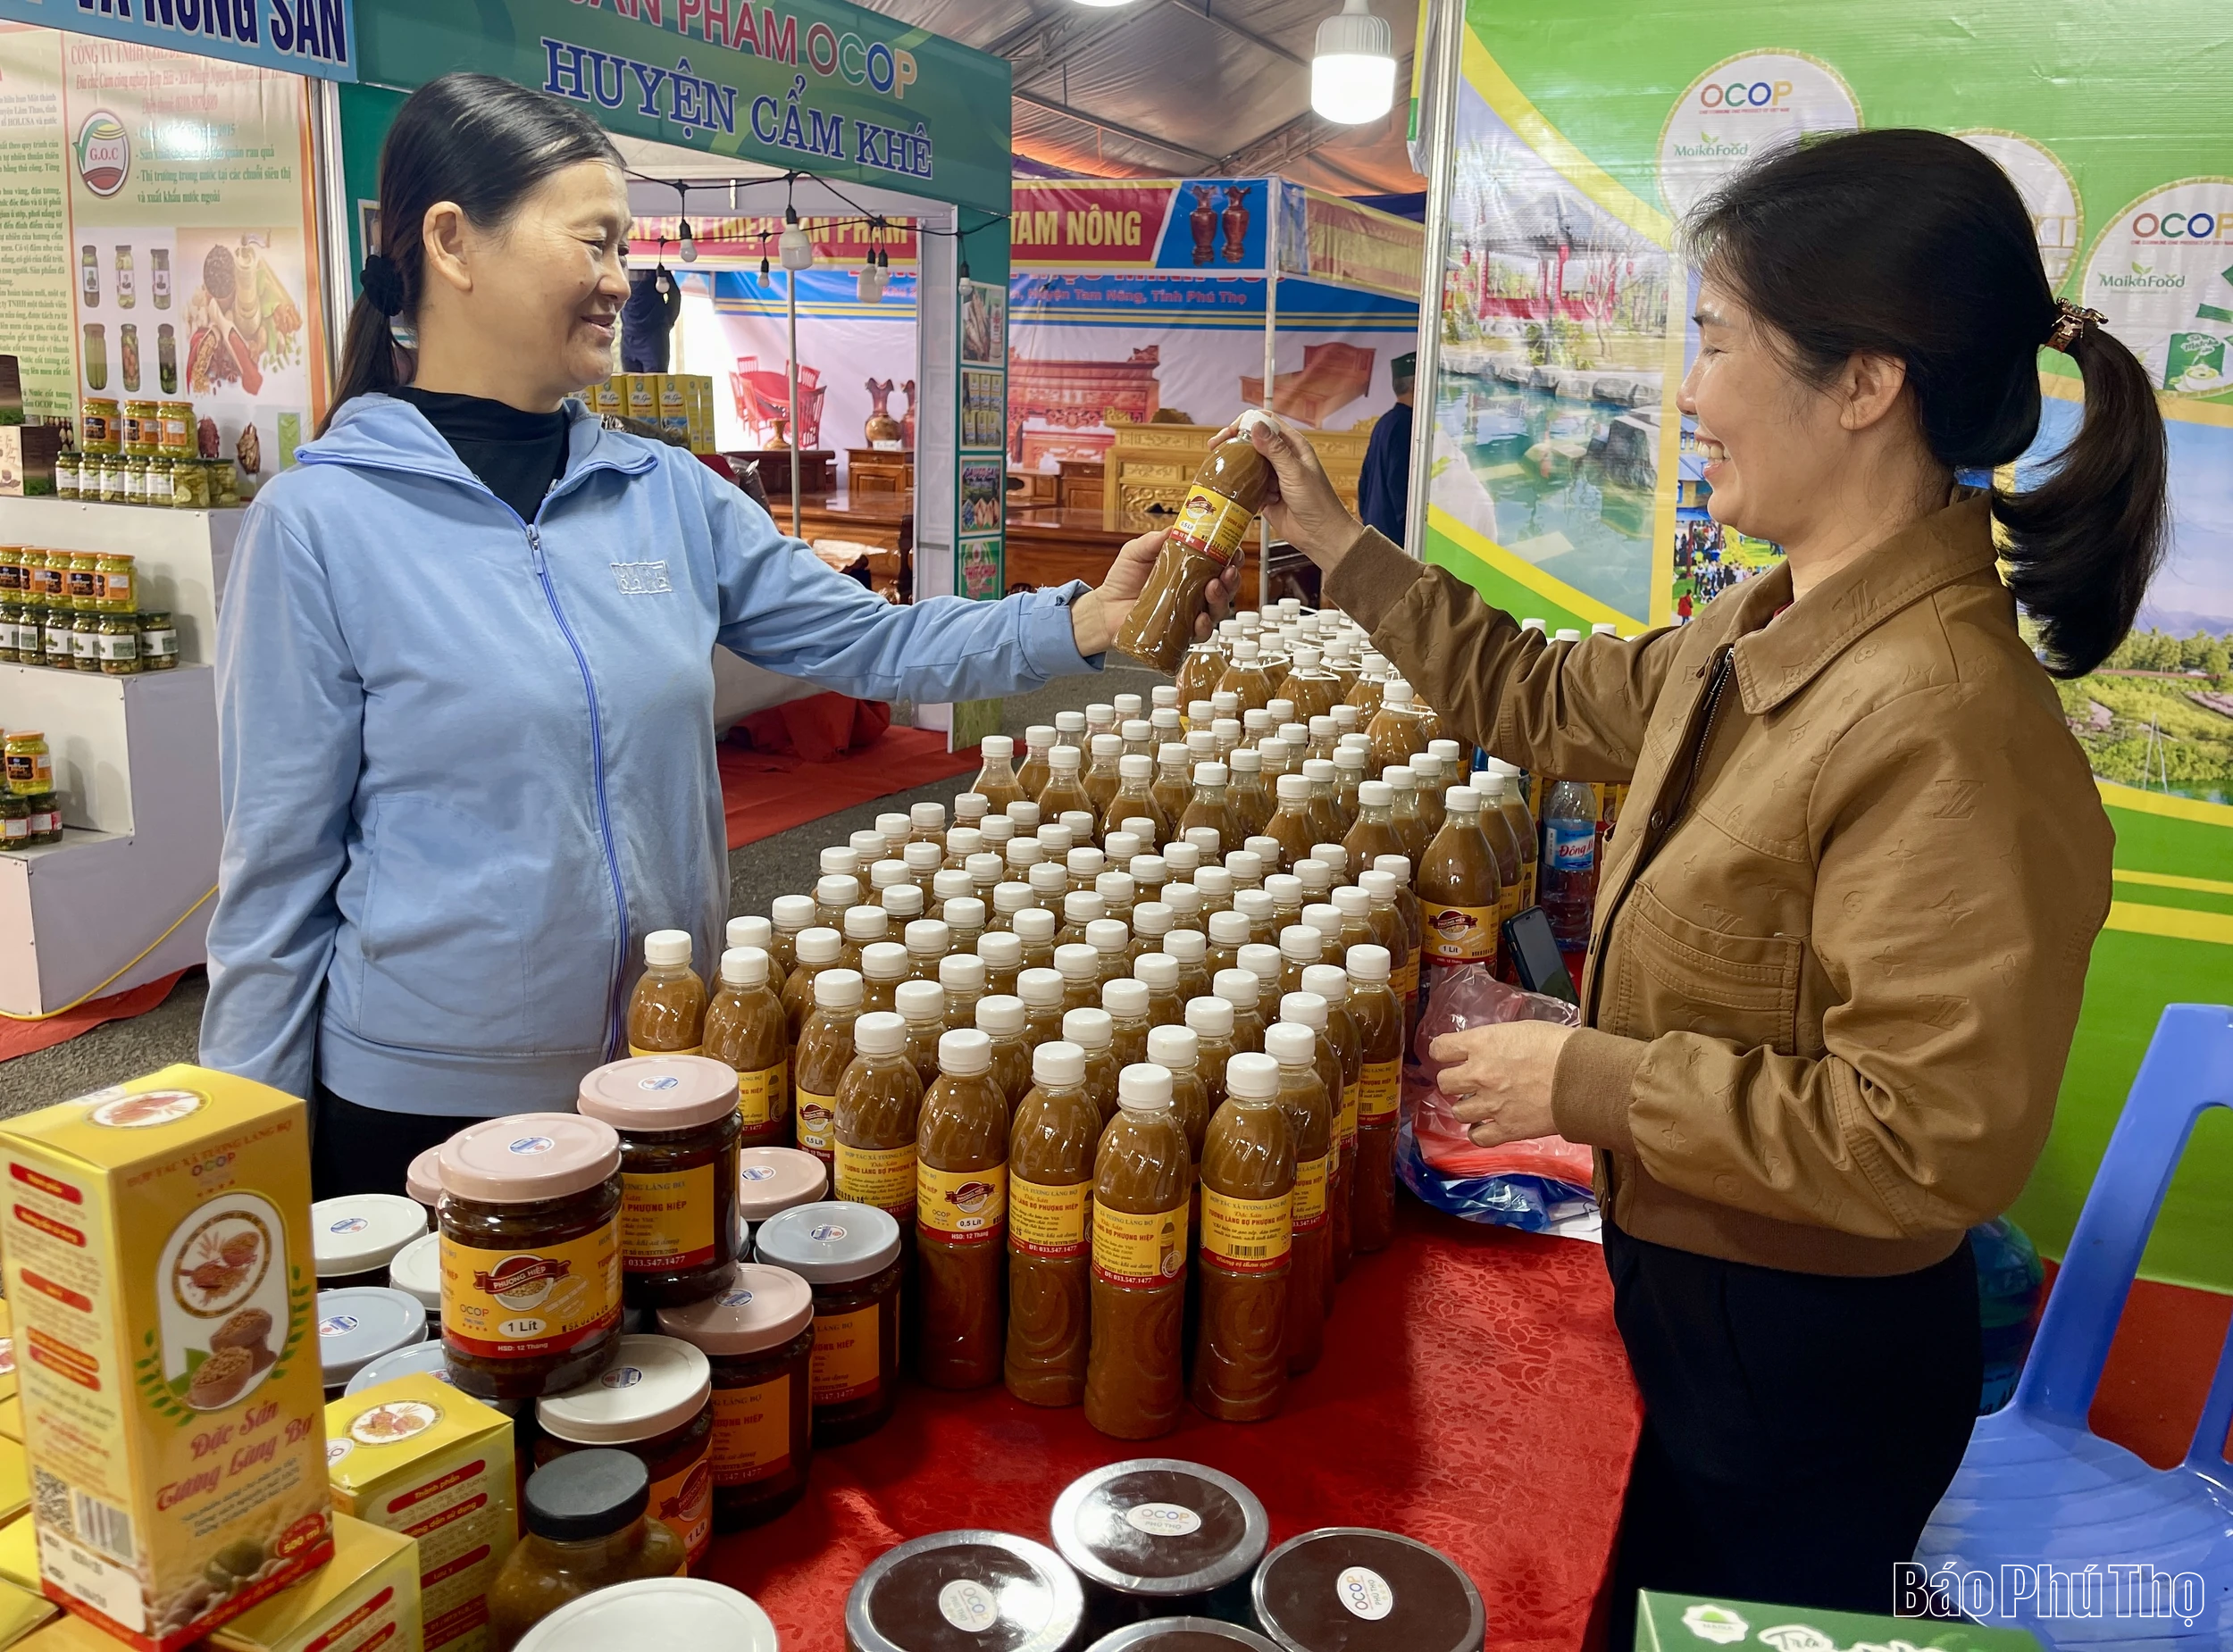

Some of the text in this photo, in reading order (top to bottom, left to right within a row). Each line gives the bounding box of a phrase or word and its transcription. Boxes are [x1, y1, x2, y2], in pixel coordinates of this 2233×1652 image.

[102, 45, 112, 63] TY
[807, 22, 917, 99] OCOP
[1701, 80, 1794, 108] OCOP
[540, 36, 933, 179] HUYỆN CẨM KHÊ
[89, 147, 118, 161] G.O.C
[1675, 143, 1748, 157] MaikaFood
[1010, 204, 1142, 246] TAM NÔNG
[2133, 213, 2233, 238] OCOP
[2099, 274, 2186, 288] MaikaFood
[1074, 288, 1102, 301] Tam
[1186, 290, 1216, 303] Phú
[1219, 291, 1248, 305] Thọ
[192, 1152, 237, 1177] OCOP
[932, 1208, 950, 1217] OCOP
[1039, 1245, 1077, 1254] 033.547.1477
[628, 1256, 686, 1267] 033.547.1477
[493, 1264, 547, 1290] PHƯỢNG HIỆP
[1113, 1274, 1152, 1284] 033.547.1477
[459, 1304, 489, 1317] OCOP
[508, 1320, 539, 1333] 1 Lít
[498, 1345, 515, 1353] HSD:
[1142, 1508, 1191, 1521] OCOP
[305, 1525, 321, 1541] ml
[1346, 1575, 1369, 1611] OCOP
[963, 1587, 990, 1621] OCOP
